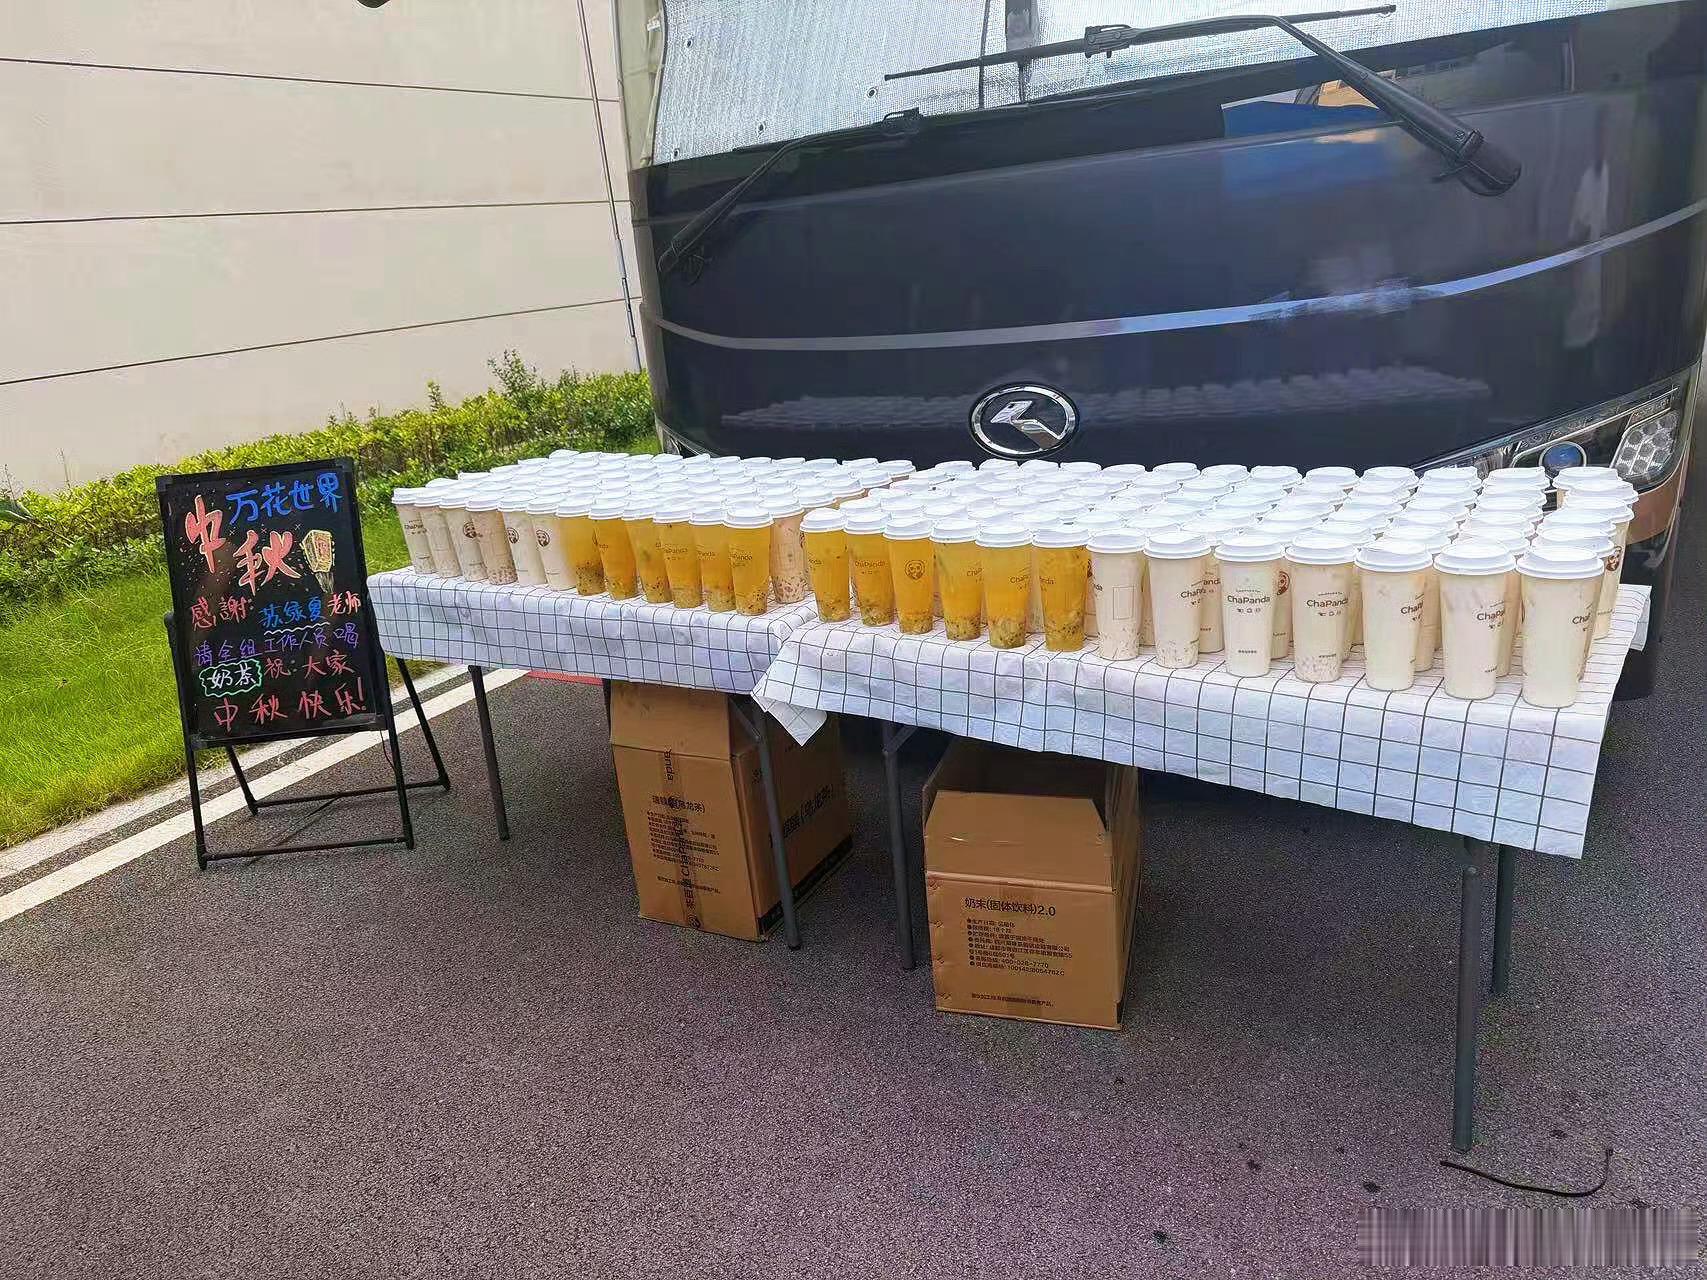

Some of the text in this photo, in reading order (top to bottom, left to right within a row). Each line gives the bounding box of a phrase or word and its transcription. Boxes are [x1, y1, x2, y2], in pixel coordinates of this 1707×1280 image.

[225, 472, 344, 525] 万花世界
[184, 493, 302, 596] 中秋
[1227, 594, 1271, 605] ChaPanda
[206, 664, 258, 690] 奶茶
[213, 676, 367, 732] 中秋快乐!
